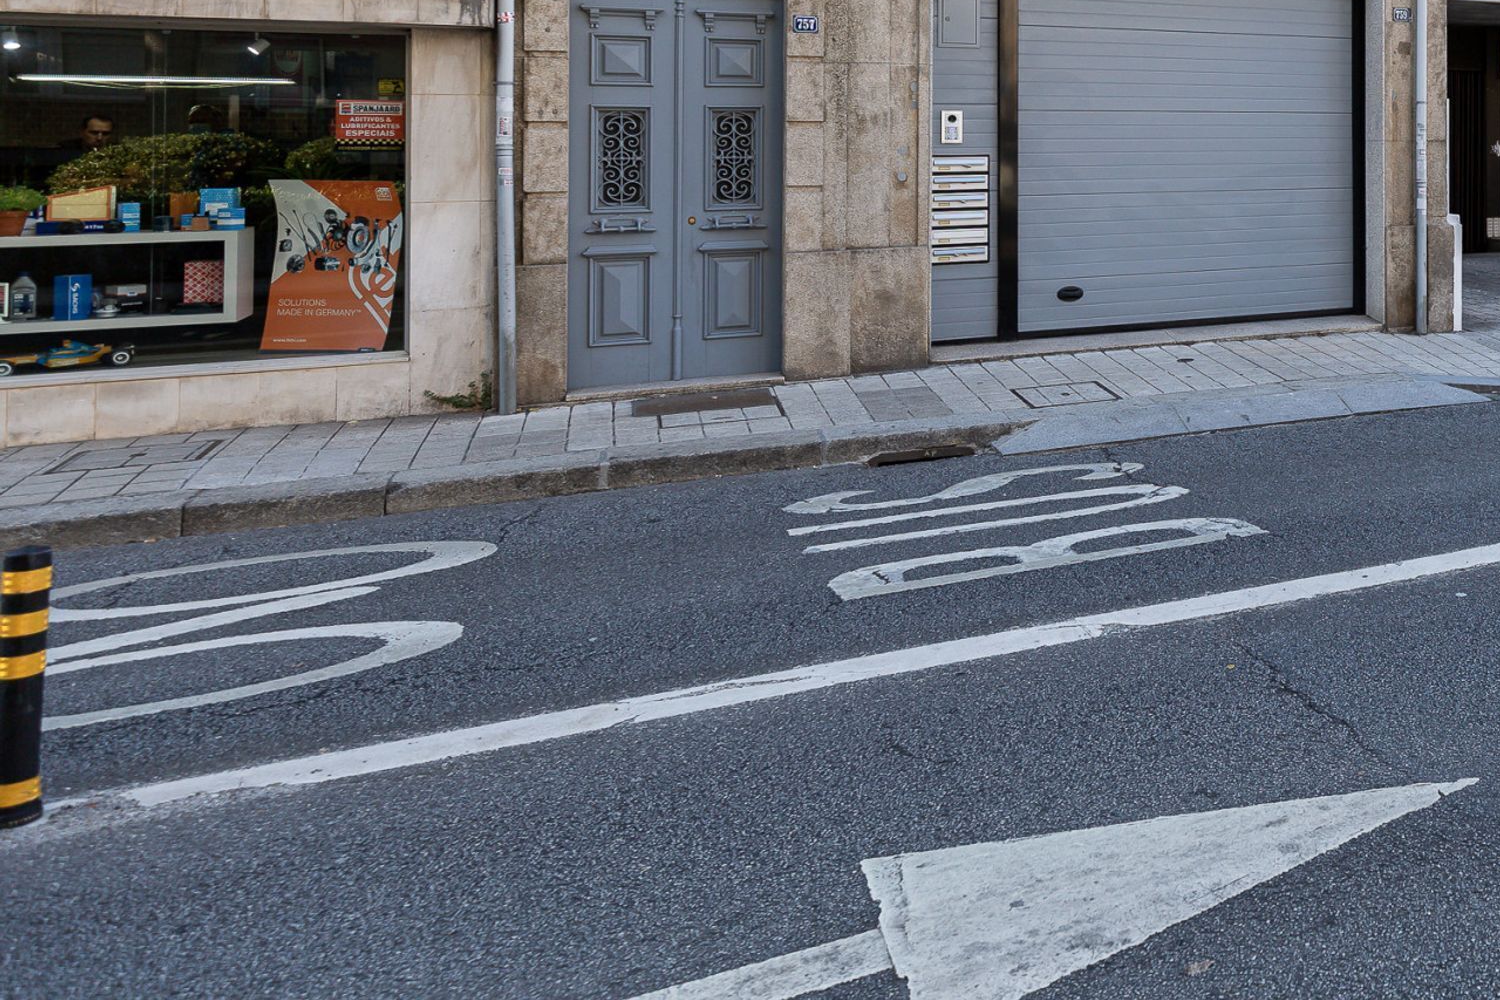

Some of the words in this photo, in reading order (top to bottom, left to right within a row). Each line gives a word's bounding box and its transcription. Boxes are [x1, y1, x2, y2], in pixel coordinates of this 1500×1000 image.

[796, 18, 815, 30] 757
[345, 129, 396, 137] ESPECIAIS
[278, 299, 327, 307] SOLUTIONS
[277, 308, 302, 316] MADE
[304, 308, 313, 316] IN
